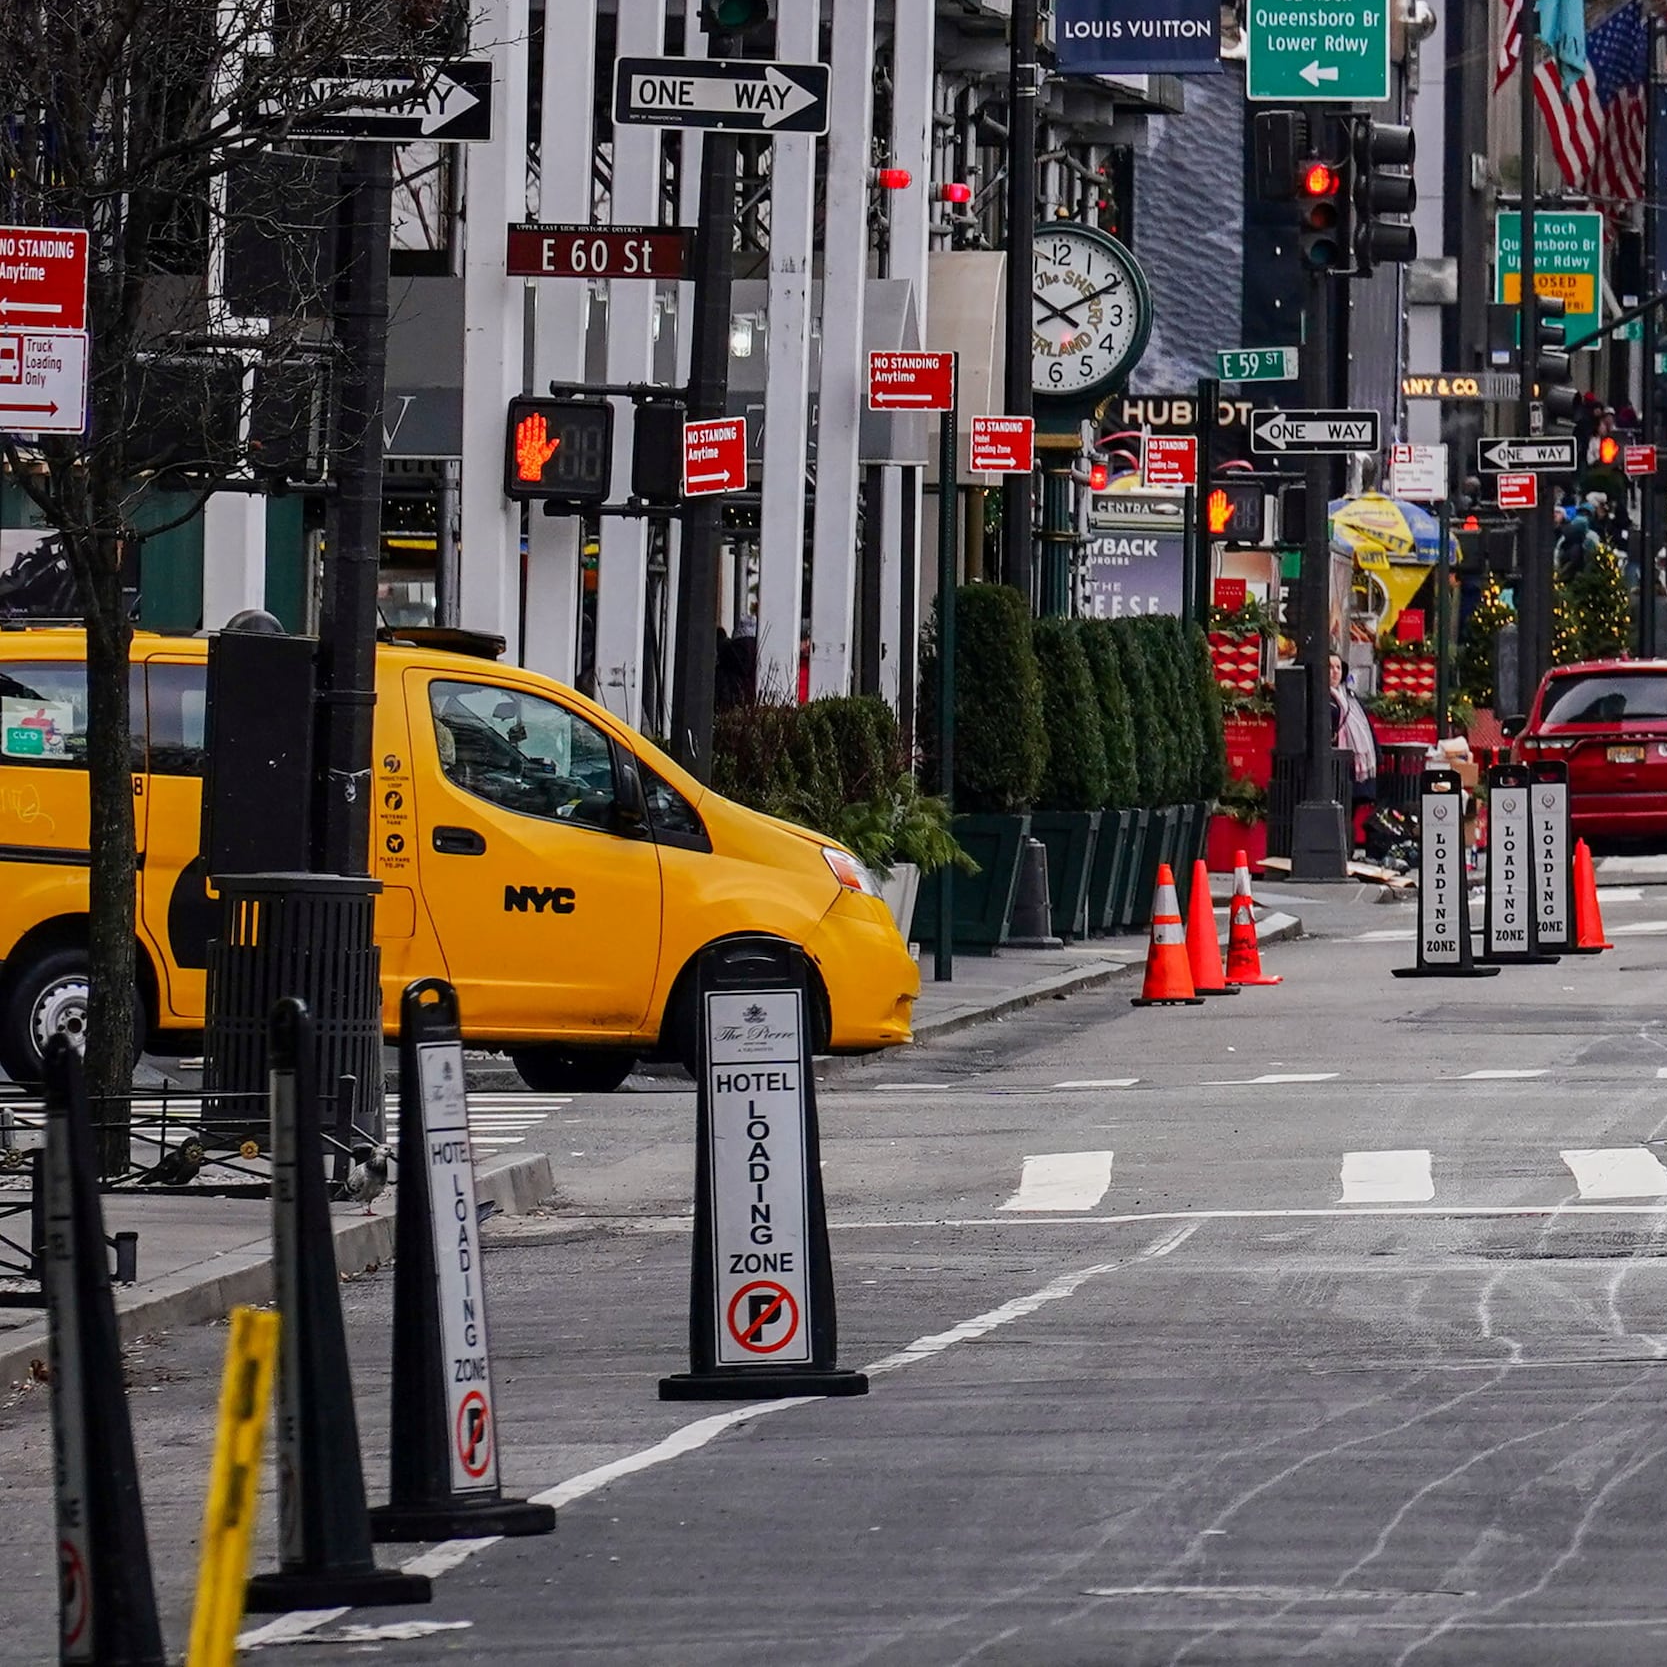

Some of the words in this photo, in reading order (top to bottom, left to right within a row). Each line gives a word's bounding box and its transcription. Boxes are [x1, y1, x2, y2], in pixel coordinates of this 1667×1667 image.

[1255, 9, 1355, 28] Queensboro
[1363, 10, 1381, 28] Br
[1065, 21, 1122, 38] LOUIS
[1128, 20, 1211, 37] VUITTON
[1267, 35, 1316, 52] Lower
[1325, 35, 1369, 56] Rdwy
[639, 79, 694, 106] ONE
[735, 83, 792, 110] WAY
[1544, 222, 1577, 235] Koch
[0, 238, 15, 257] NO
[18, 239, 75, 260] STANDING
[542, 238, 556, 271] E
[571, 239, 608, 272] 60
[623, 239, 653, 273] St
[1053, 244, 1071, 266] 12
[1583, 240, 1596, 252] Br
[1554, 255, 1590, 269] Rdwy
[0, 261, 46, 284] Anytime
[1110, 304, 1123, 327] 3
[27, 338, 53, 353] Truck
[1099, 333, 1114, 354] 4
[25, 355, 62, 373] Loading
[874, 357, 888, 369] NO
[891, 357, 939, 369] STANDING
[1049, 362, 1063, 383] 6
[1079, 355, 1093, 377] 5
[1223, 355, 1233, 378] E
[1239, 353, 1259, 377] 59
[1265, 353, 1279, 365] ST
[25, 372, 46, 389] Only
[875, 371, 916, 384] Anytime
[1438, 378, 1450, 396] &
[1123, 399, 1253, 426] HUBOT
[688, 430, 699, 445] NO
[700, 426, 737, 443] STANDING
[975, 421, 985, 432] NO
[987, 421, 1023, 433] STANDING
[1270, 424, 1306, 439] ONE
[1328, 424, 1367, 439] WAY
[688, 445, 719, 463] Anytime
[1159, 440, 1189, 451] STANDING
[1499, 449, 1524, 460] ONE
[1537, 448, 1565, 460] WAY
[1097, 501, 1154, 514] CENTRA
[1503, 825, 1516, 925] LOADING
[1543, 820, 1555, 916] LOADING
[1435, 833, 1447, 935] LOADING
[504, 885, 575, 914] NYC
[1495, 930, 1524, 941] ZONE
[1537, 921, 1563, 932] ZONE
[1426, 940, 1456, 952] ZONE
[714, 1026, 743, 1042] The
[747, 1024, 795, 1040] Pierre
[716, 1072, 795, 1094] HOTEL
[746, 1100, 774, 1245] LOADING
[452, 1174, 478, 1347] LOADING
[729, 1252, 794, 1274] ZONE
[454, 1358, 487, 1383] ZONE
